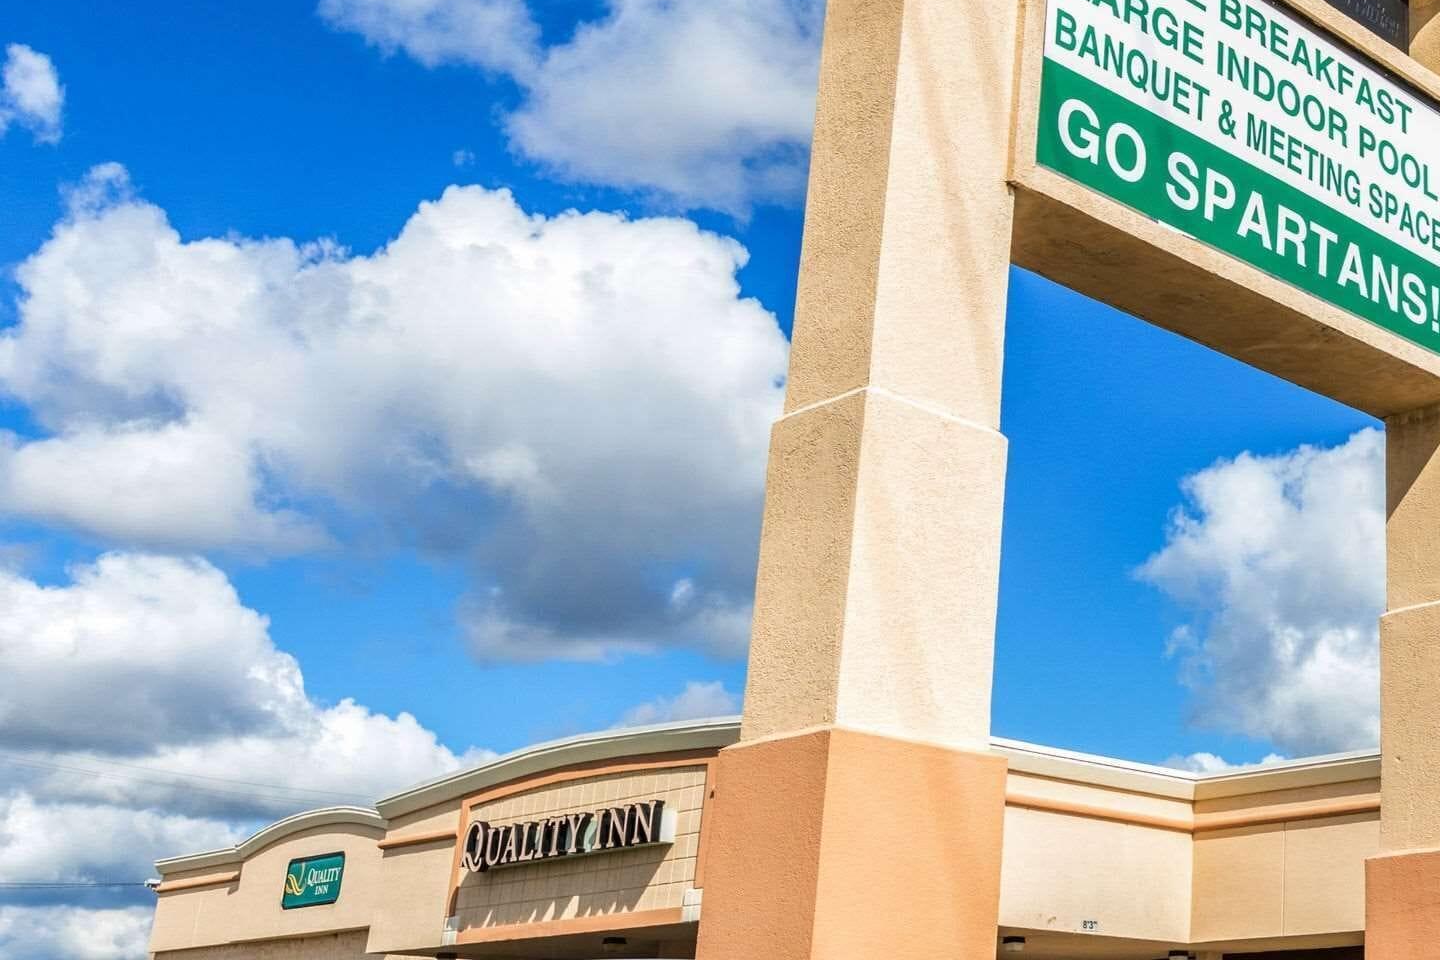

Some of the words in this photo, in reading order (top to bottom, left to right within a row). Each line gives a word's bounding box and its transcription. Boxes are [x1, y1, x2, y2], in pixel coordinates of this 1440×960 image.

[1055, 7, 1210, 121] BANQUET
[1218, 99, 1236, 139] &
[1246, 112, 1360, 207] MEETING
[1216, 40, 1348, 148] INDOOR
[1359, 125, 1438, 202] POOL
[1057, 98, 1147, 183] GO
[1165, 151, 1440, 334] SPARTANS!
[307, 867, 342, 887] QUALITY
[314, 885, 329, 896] INN
[460, 812, 588, 873] QUALITY
[592, 799, 665, 849] INN
